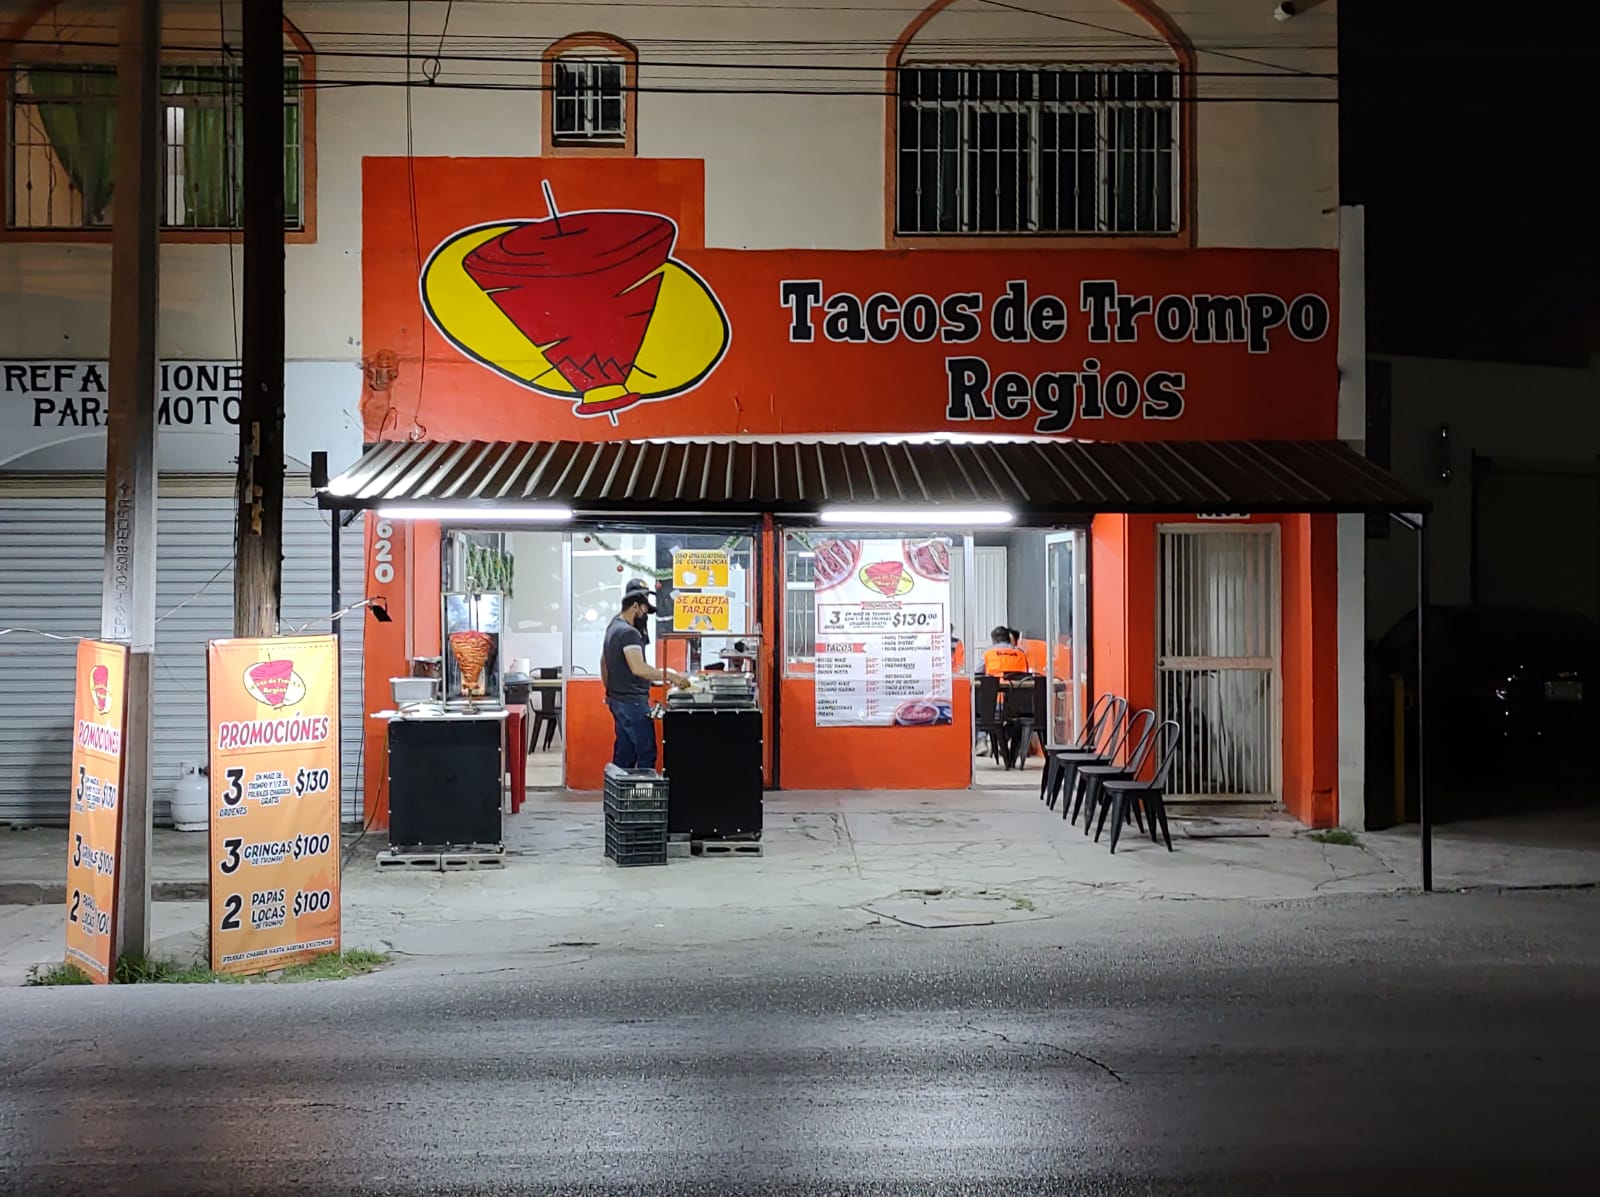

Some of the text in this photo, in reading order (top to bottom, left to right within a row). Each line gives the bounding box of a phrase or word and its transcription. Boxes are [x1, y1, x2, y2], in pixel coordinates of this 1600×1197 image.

[780, 279, 1330, 354] Tacos de Trompo
[944, 356, 1186, 433] Regios
[33, 397, 109, 427] PAR
[374, 519, 395, 584] 620
[676, 595, 729, 605] SE ACEPTA
[682, 605, 723, 615] TARJETA
[829, 610, 841, 625] 3
[826, 643, 853, 654] TACOS
[77, 766, 86, 801] 3
[223, 768, 329, 806] 3 $130
[73, 834, 82, 866] 3
[220, 834, 330, 874] 3 GRINGAS $100
[70, 889, 80, 922] 2
[221, 889, 330, 930] 2 PAPAS $100
[251, 905, 286, 924] LOCAS
